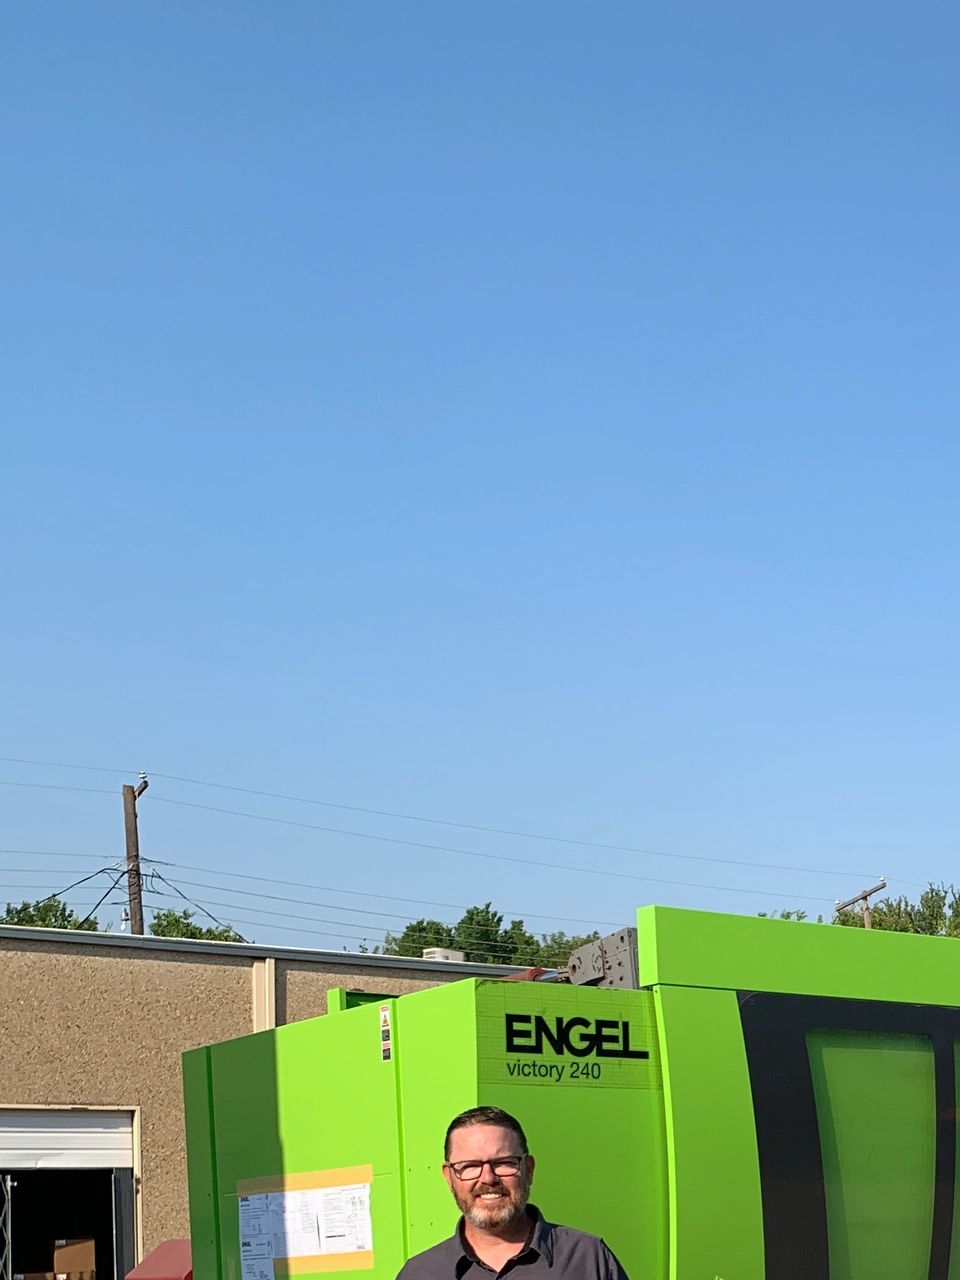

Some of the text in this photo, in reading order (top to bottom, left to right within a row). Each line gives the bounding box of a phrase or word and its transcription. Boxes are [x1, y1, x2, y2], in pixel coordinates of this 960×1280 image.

[505, 1013, 650, 1060] ENGEL
[506, 1059, 601, 1082] victory 240
